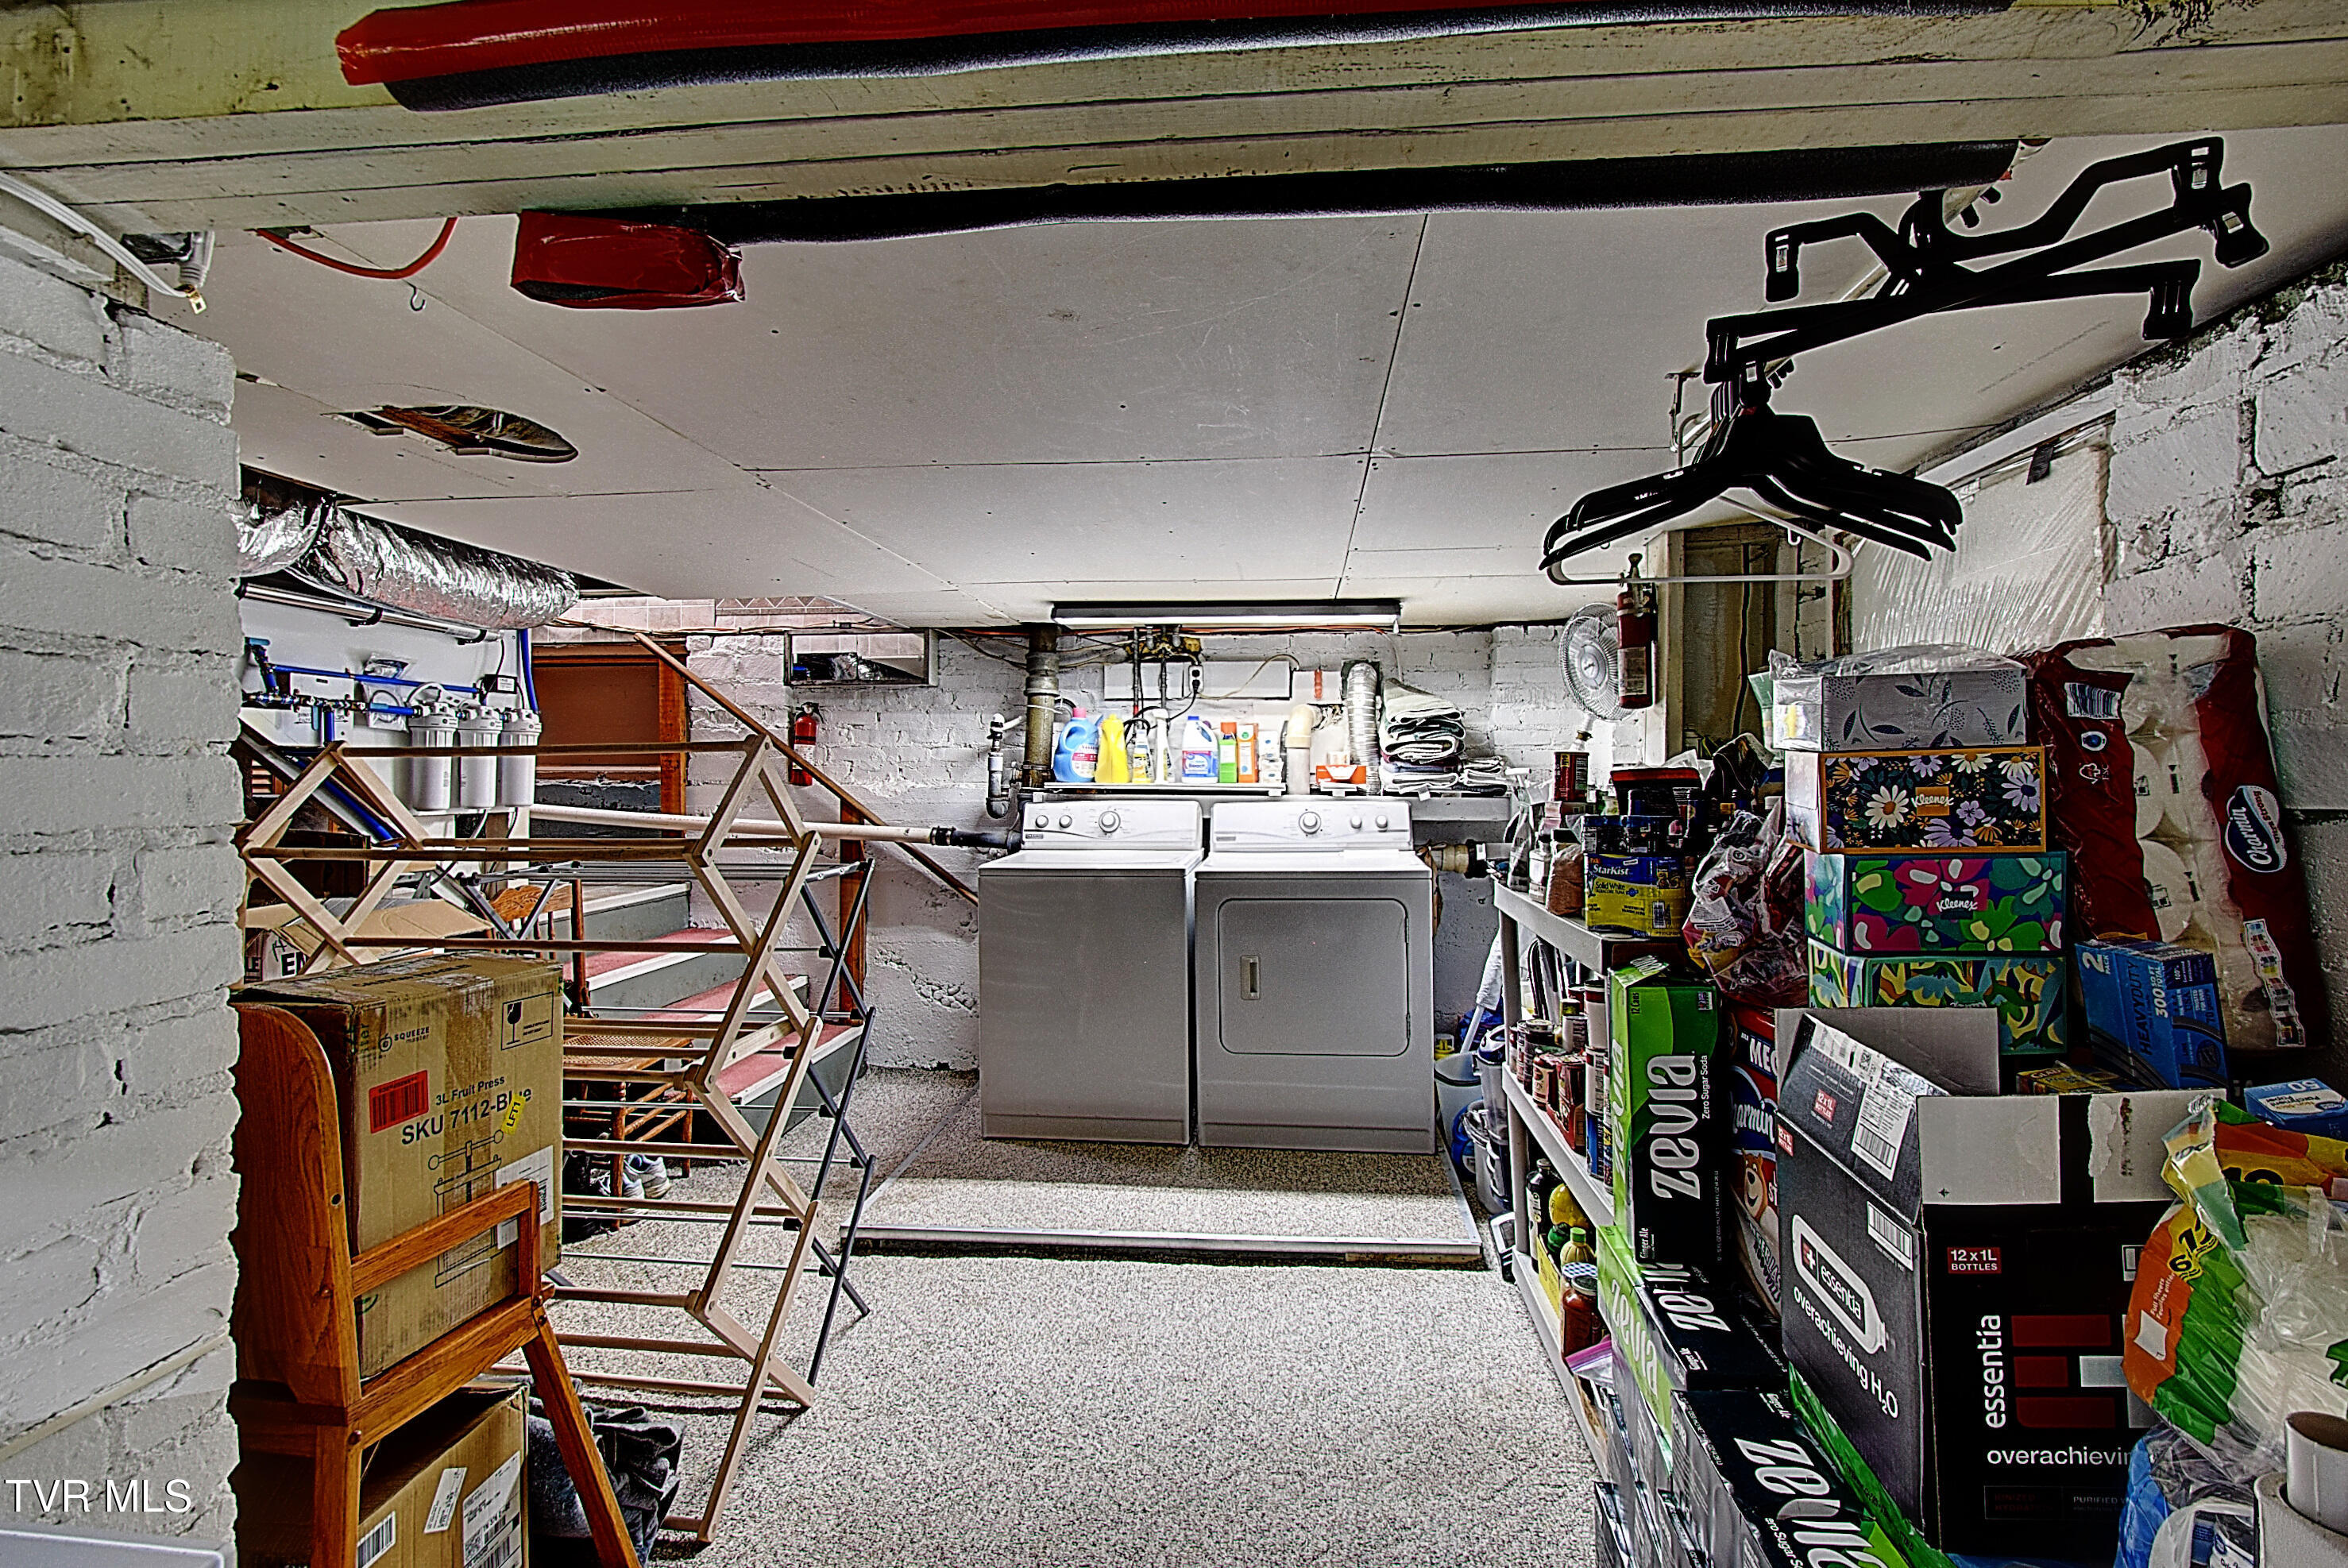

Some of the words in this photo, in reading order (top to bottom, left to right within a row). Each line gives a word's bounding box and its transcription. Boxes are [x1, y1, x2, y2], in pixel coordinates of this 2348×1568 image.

[1911, 794, 1954, 807] Kleenex
[2253, 790, 2273, 821] Strong
[2230, 807, 2273, 865] Charmin
[1593, 863, 1629, 875] StarKist
[1595, 881, 1608, 890] Solid
[1937, 898, 1978, 912] Kleenex
[2082, 952, 2105, 974] 2
[2155, 966, 2164, 987] TOTAL
[1630, 992, 1640, 1006] Cans
[2127, 960, 2153, 1056] HEAVYDUTY
[2153, 988, 2168, 1018] 300
[394, 1025, 431, 1041] SQUEEZE
[435, 1094, 449, 1106] 3L
[451, 1084, 476, 1102] Fruit
[477, 1076, 505, 1091] Press
[1701, 1076, 1710, 1100] Sugar
[2288, 1080, 2320, 1092] 50
[401, 1114, 444, 1145] SKU
[450, 1088, 531, 1130] 7112-Ble
[1701, 1101, 1710, 1119] Zero
[1730, 1091, 1775, 1144] harmin
[1647, 1056, 1701, 1199] zevia
[1639, 1227, 1649, 1237] Ale
[1950, 1249, 1967, 1261] 12
[1970, 1252, 1977, 1261] x
[1979, 1249, 1998, 1261] 1L
[1821, 1265, 1862, 1320] essentia
[2153, 1277, 2166, 1300] Sheets
[2149, 1301, 2159, 1315] Full
[1612, 1279, 1658, 1400] zevia
[1793, 1286, 1869, 1391] overachieving
[1975, 1315, 2006, 1429] essentia
[2072, 1496, 2118, 1504] PURIFIED
[1764, 1517, 1779, 1531] ero
[1774, 1531, 1797, 1560] Sugar
